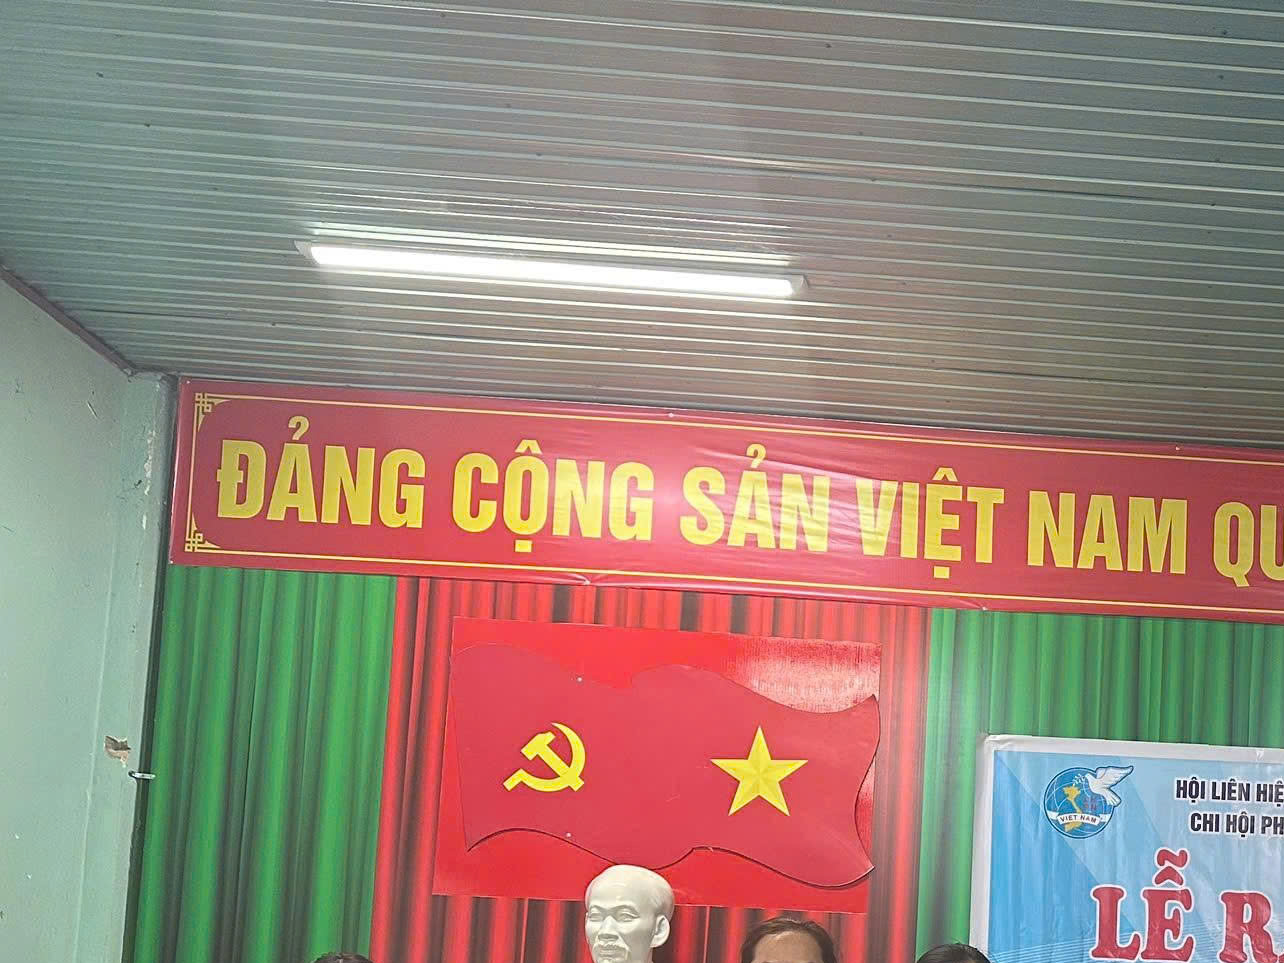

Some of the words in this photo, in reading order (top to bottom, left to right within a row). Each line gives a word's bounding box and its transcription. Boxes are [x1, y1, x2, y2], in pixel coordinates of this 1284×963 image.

[218, 415, 425, 528] ĐẢNG
[452, 439, 654, 553] CỘNG
[680, 444, 830, 553] SẢN
[855, 467, 1005, 579] VIỆT
[1027, 490, 1188, 575] NAM
[1176, 776, 1206, 803] HỘI
[1211, 778, 1251, 802] LIÊN
[1190, 812, 1220, 833] CHI
[1225, 811, 1255, 837] HỘI
[1091, 848, 1195, 963] LỄ
